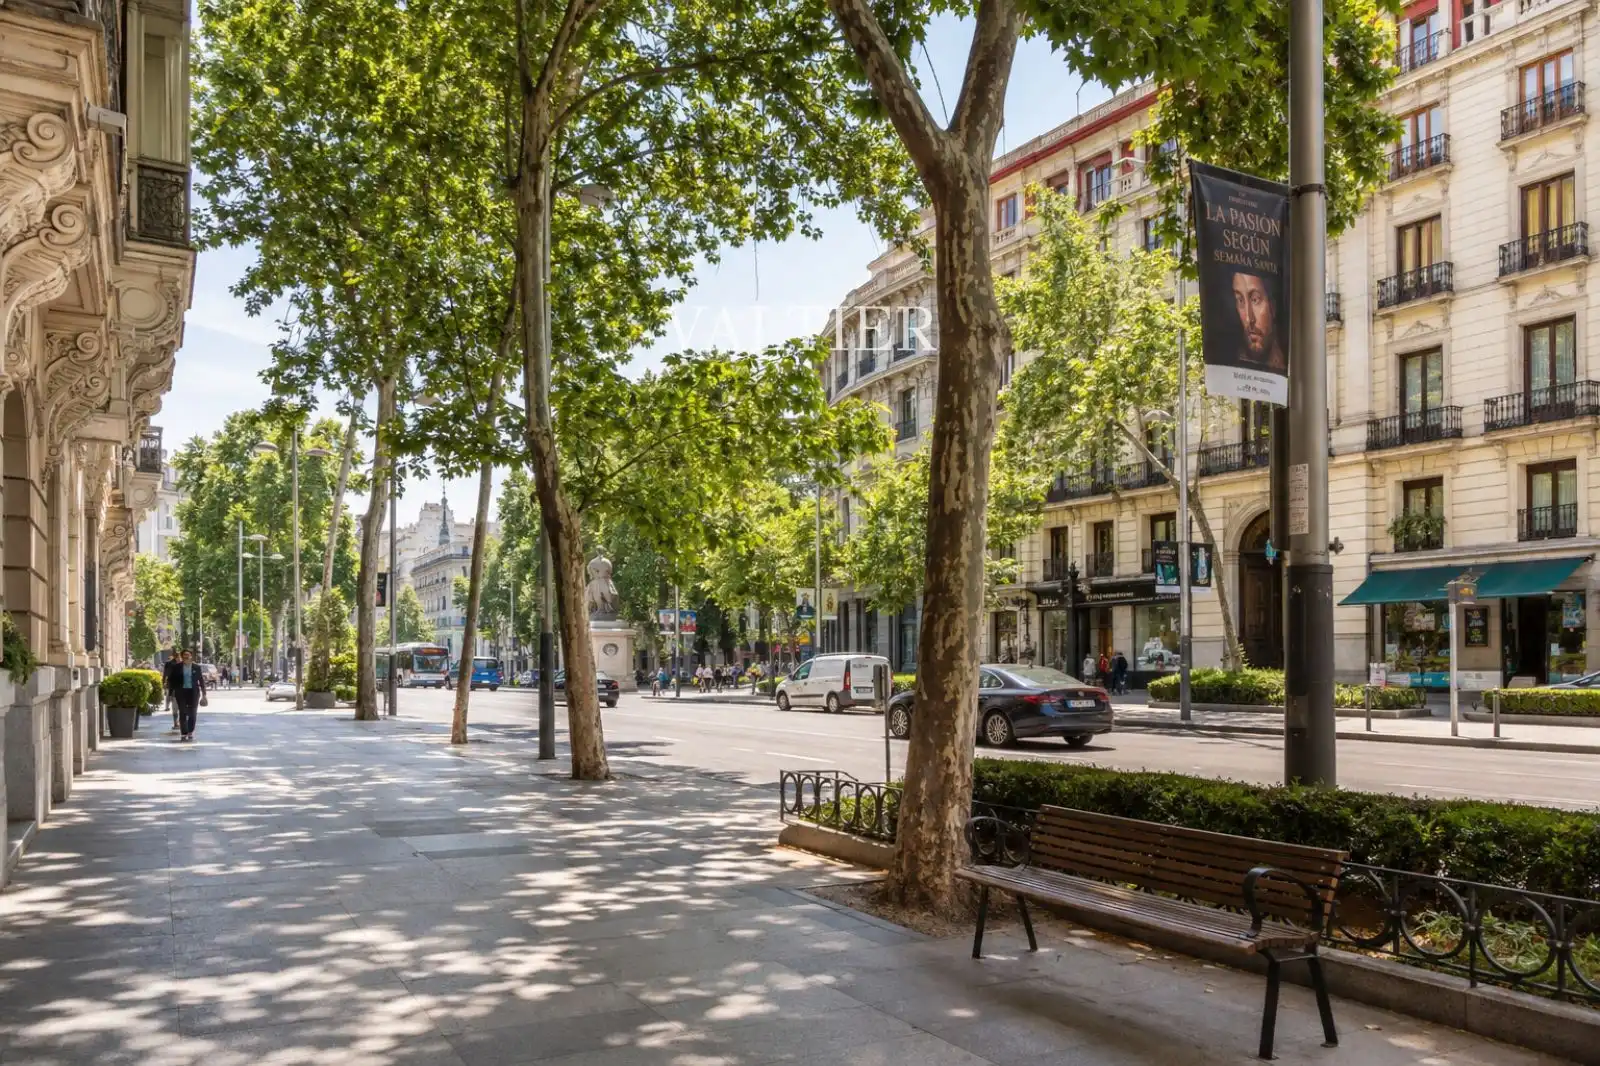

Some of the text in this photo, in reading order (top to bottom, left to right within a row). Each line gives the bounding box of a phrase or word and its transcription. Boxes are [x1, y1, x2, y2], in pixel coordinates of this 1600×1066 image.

[1206, 201, 1226, 223] LA
[1229, 207, 1280, 237] PASIÓN
[1223, 228, 1270, 257] SEGÚN
